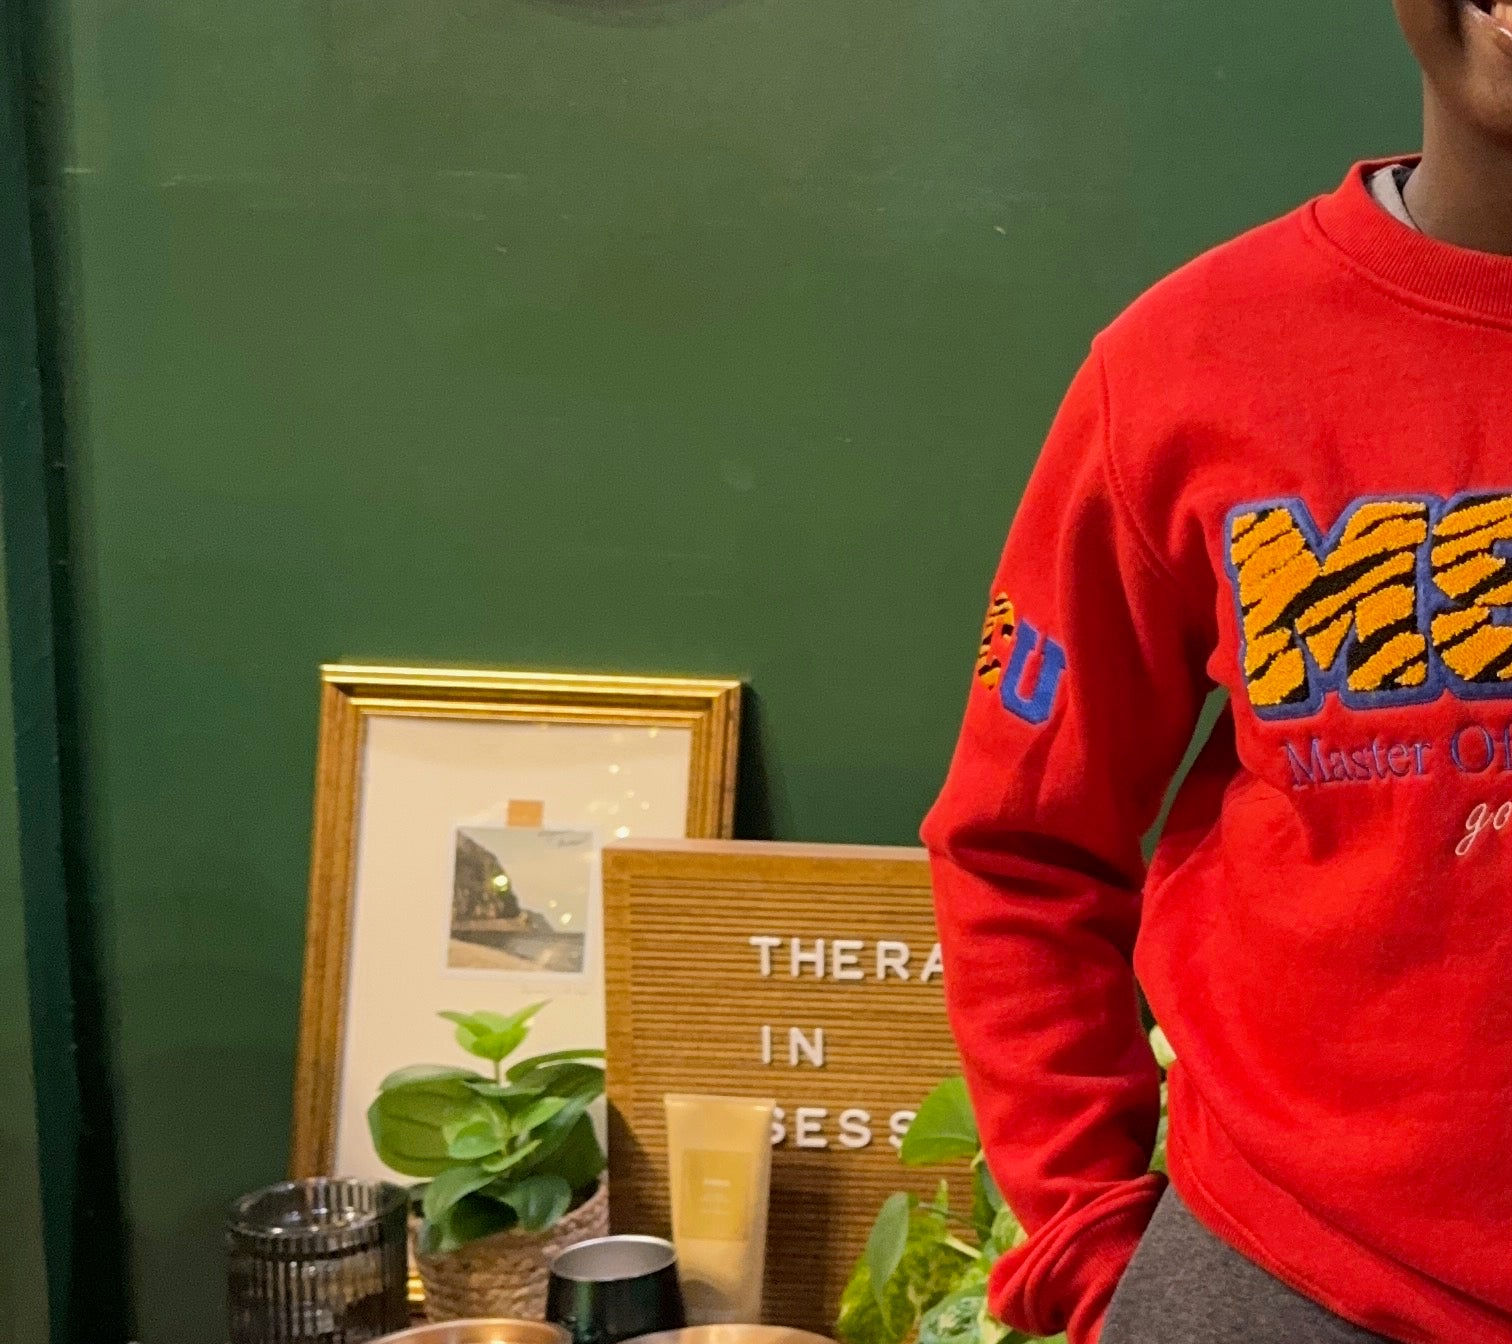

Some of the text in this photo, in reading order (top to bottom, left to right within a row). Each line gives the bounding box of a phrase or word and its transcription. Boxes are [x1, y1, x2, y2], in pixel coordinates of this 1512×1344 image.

[1283, 735, 1431, 791] Master
[1455, 801, 1512, 856] go
[761, 1025, 826, 1068] IN
